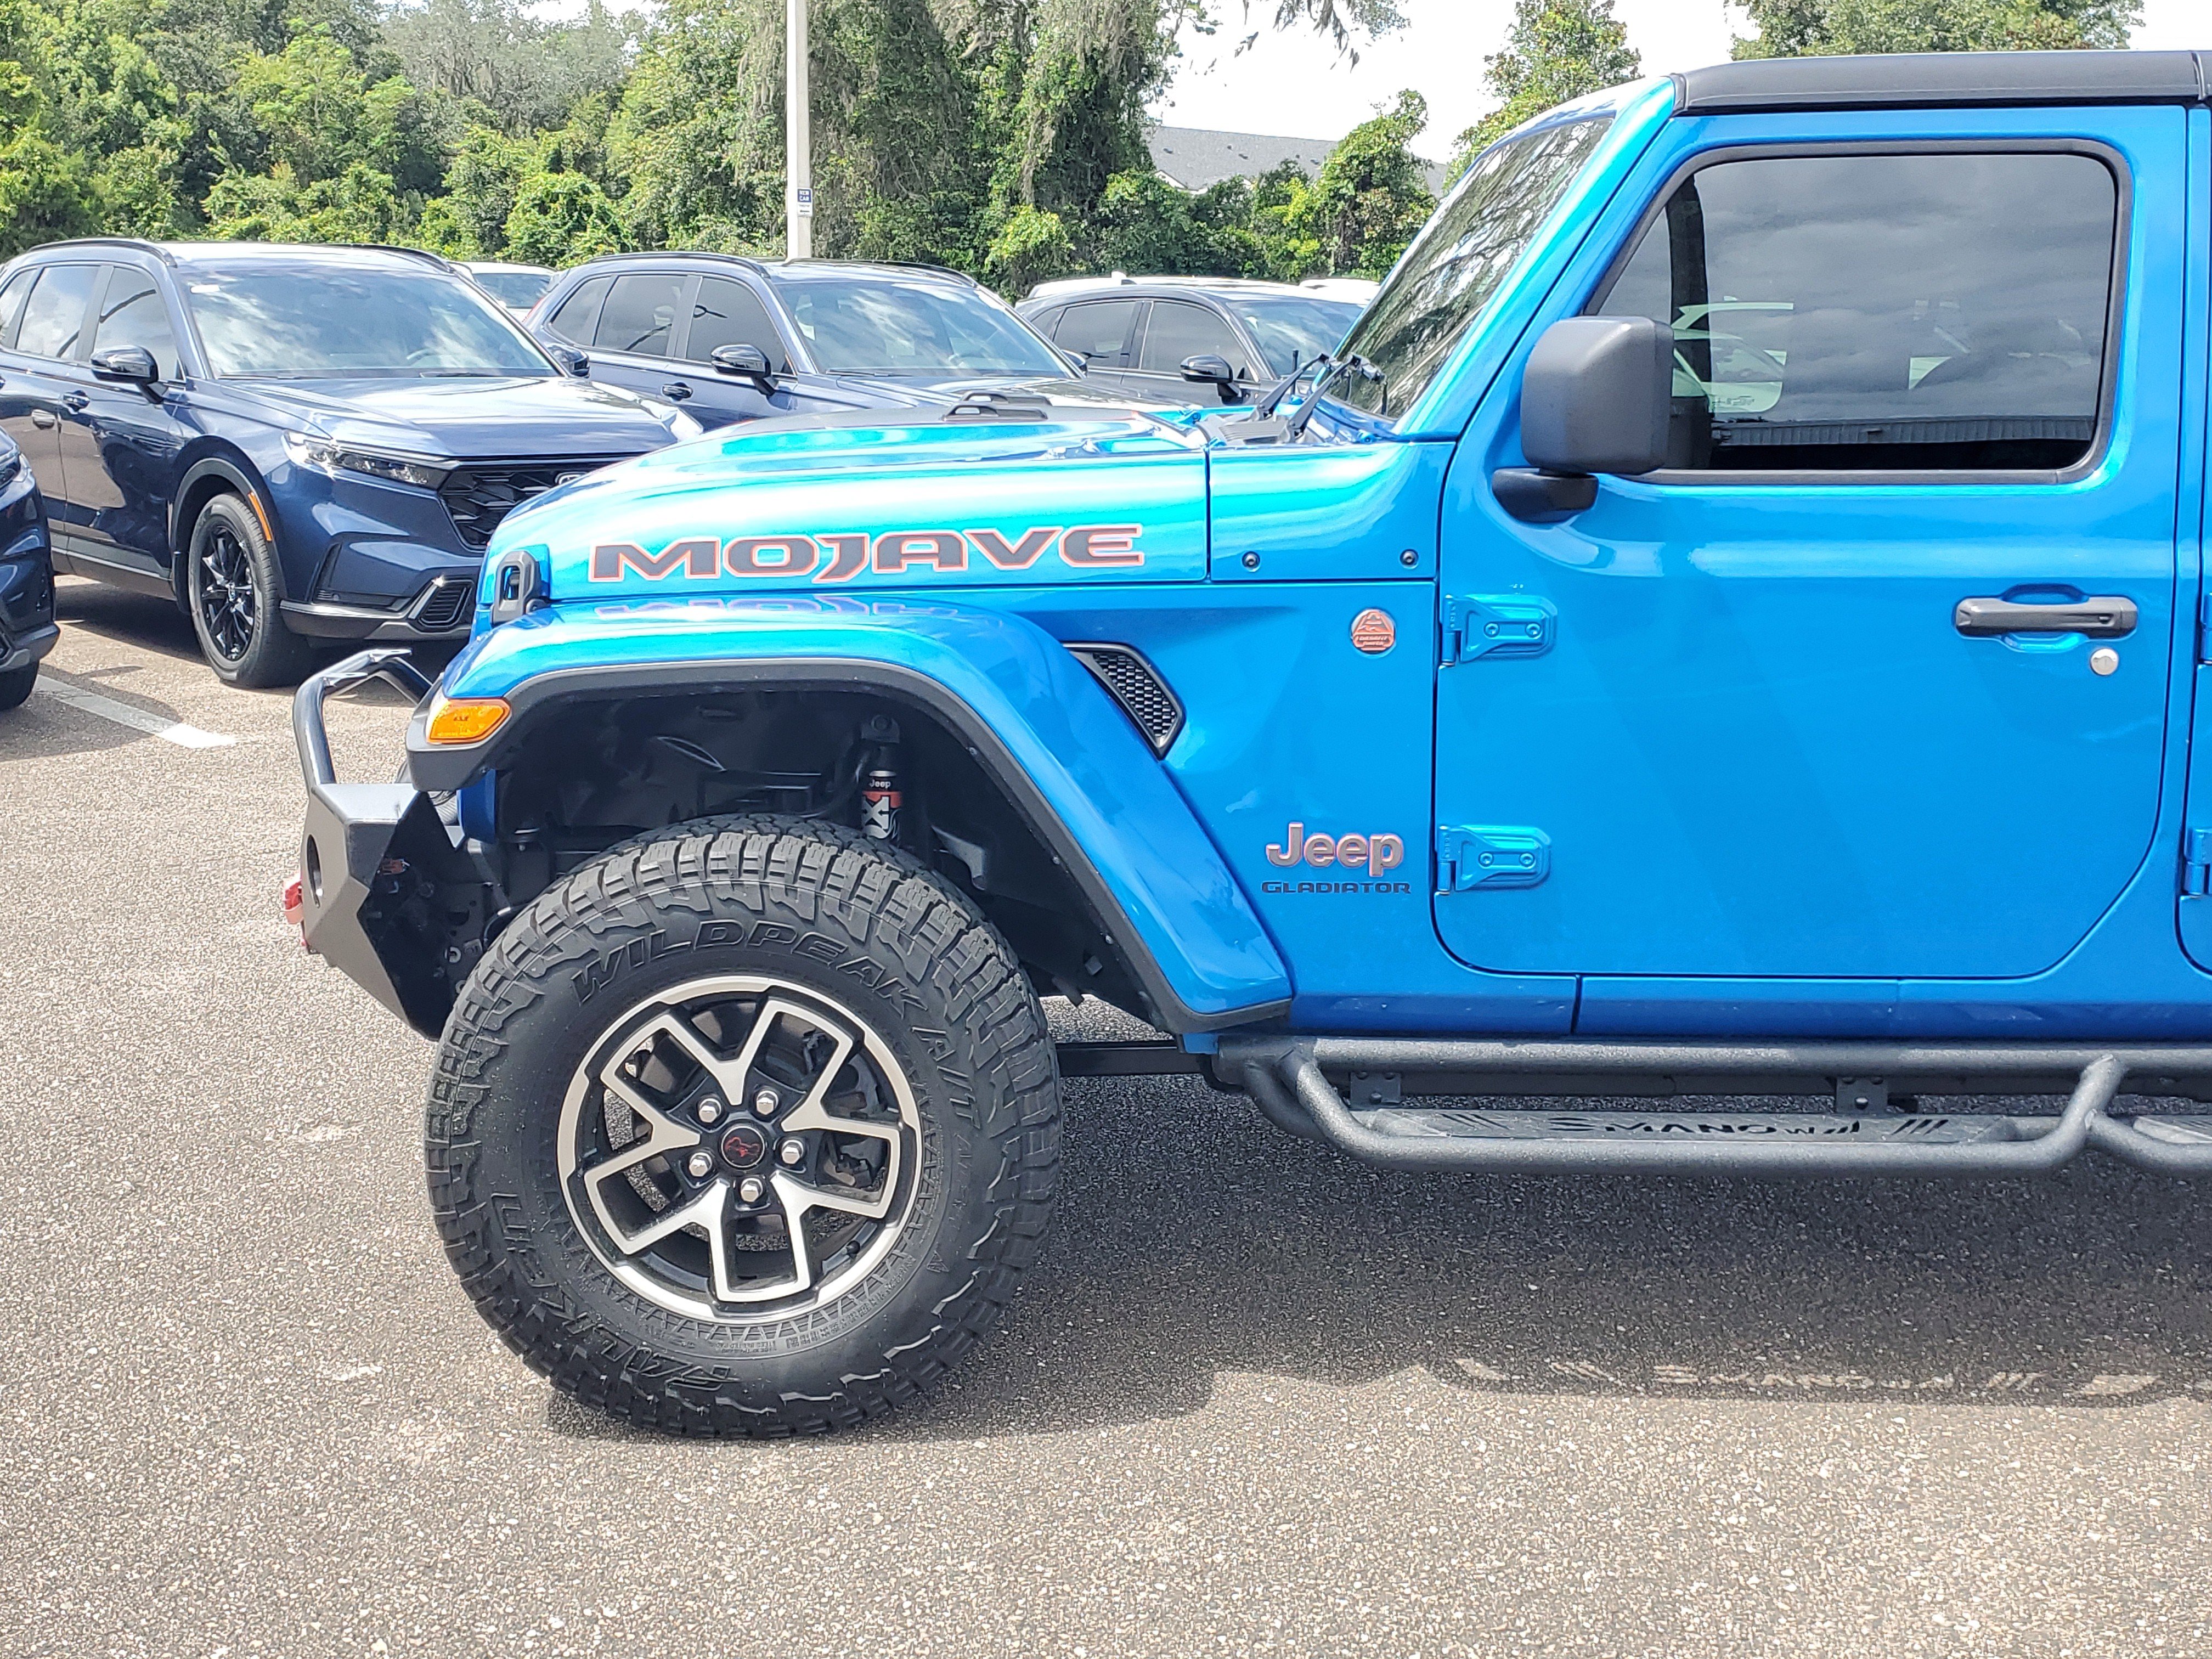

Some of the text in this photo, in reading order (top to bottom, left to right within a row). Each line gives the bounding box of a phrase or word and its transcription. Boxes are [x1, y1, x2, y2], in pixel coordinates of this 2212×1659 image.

[589, 524, 1145, 584] MOJAVE
[869, 779, 891, 789] Jeep
[1266, 822, 1404, 877] Jeep
[1261, 881, 1412, 894] GLADIATOR
[569, 919, 929, 1019] WILDPEAK
